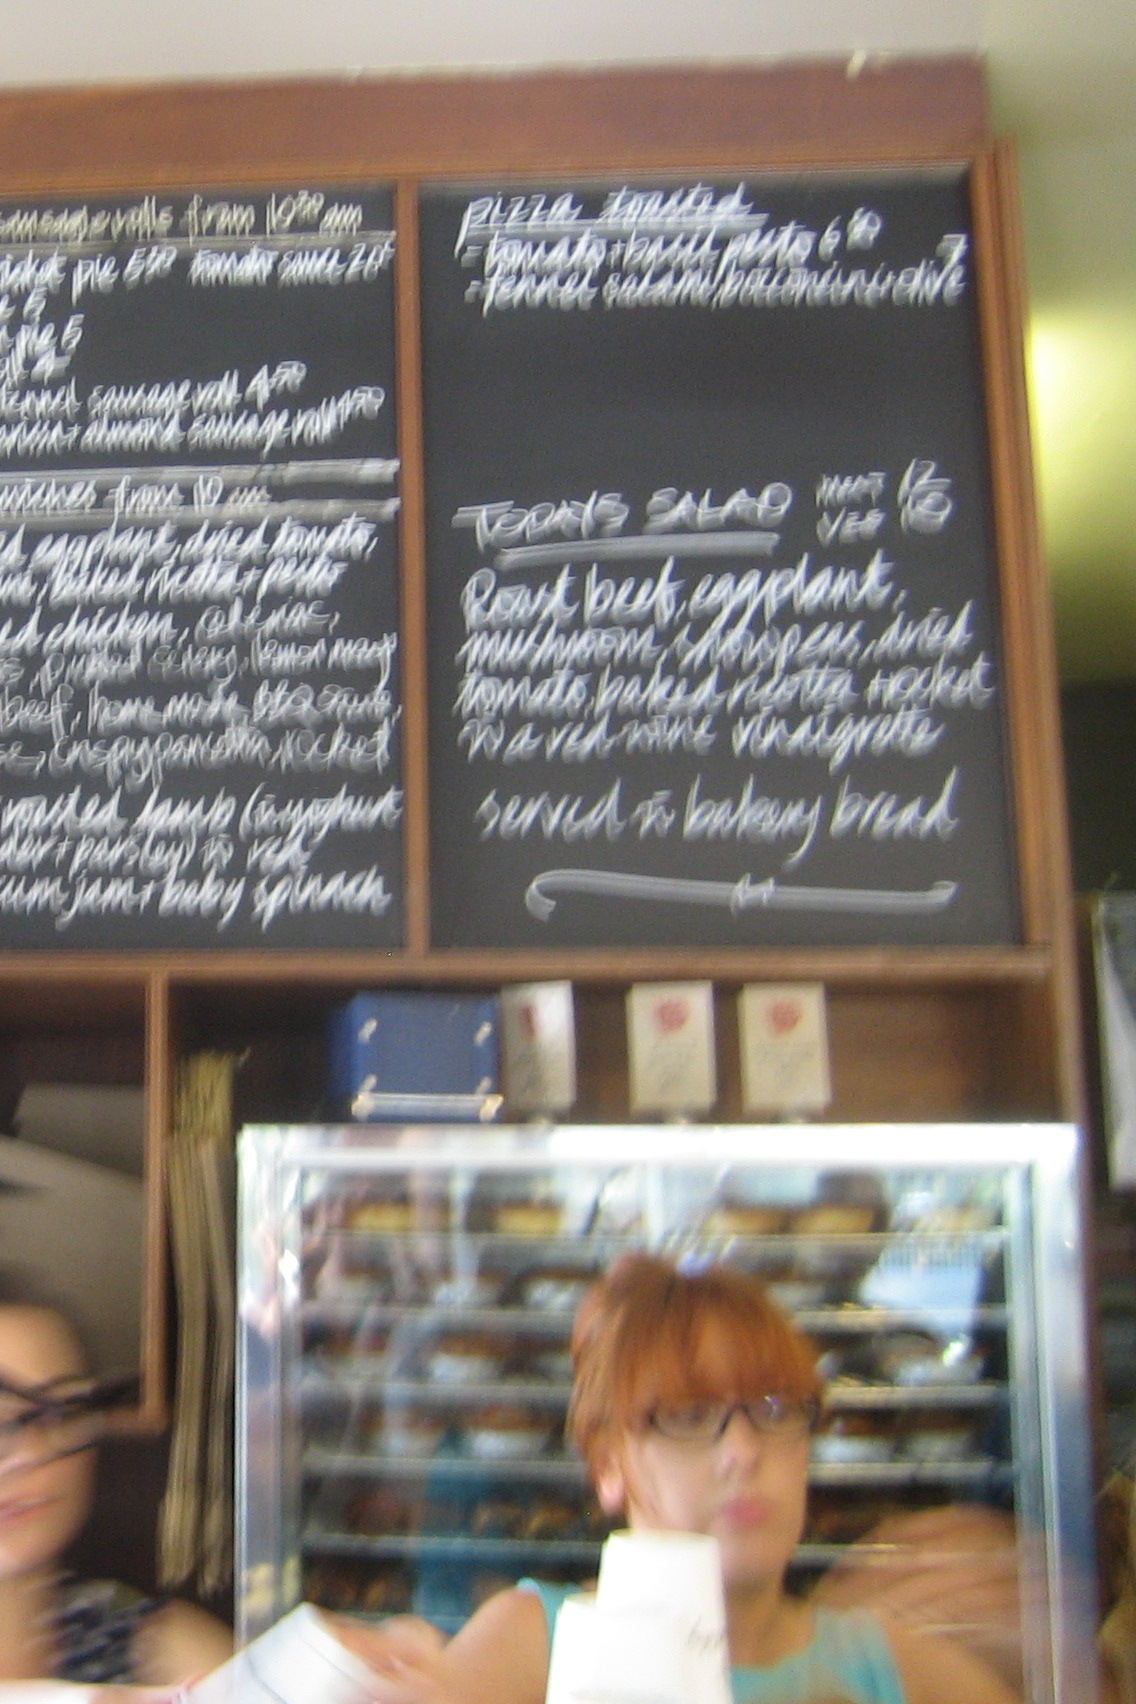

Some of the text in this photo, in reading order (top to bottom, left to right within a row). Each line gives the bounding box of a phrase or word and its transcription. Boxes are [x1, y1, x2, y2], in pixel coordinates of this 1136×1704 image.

[109, 195, 175, 242] rolls
[181, 193, 257, 248] from
[455, 188, 584, 258] pizza
[70, 252, 122, 307] pie
[60, 312, 85, 356] 5
[642, 481, 795, 538] SALAD
[463, 562, 580, 628] Roast
[472, 775, 628, 842] served
[679, 772, 824, 871] bakery
[827, 765, 961, 841] bread
[156, 865, 248, 932] baby
